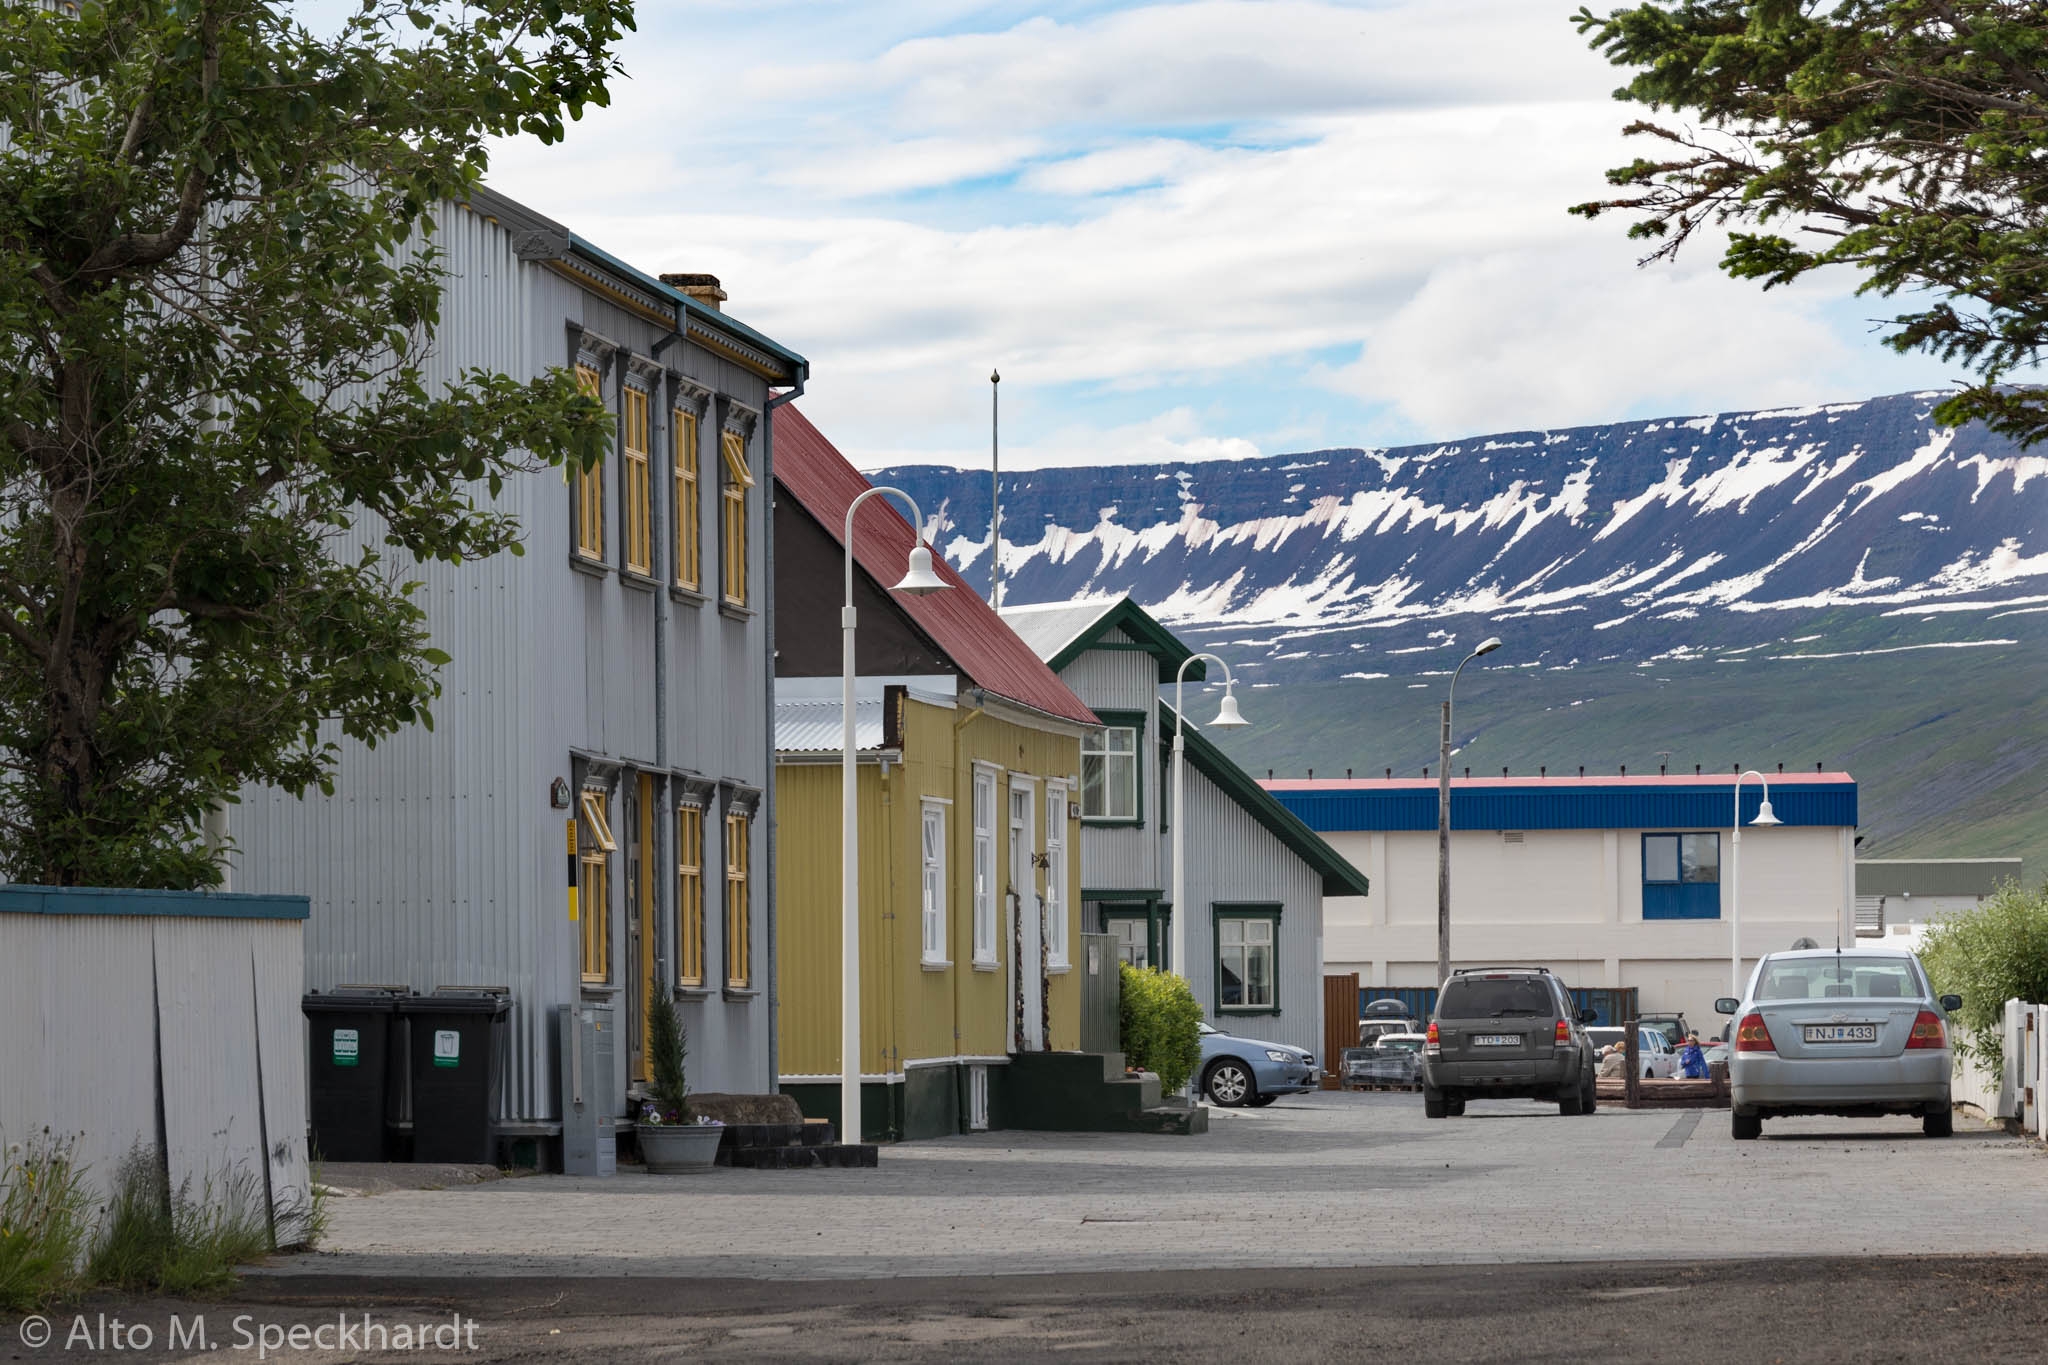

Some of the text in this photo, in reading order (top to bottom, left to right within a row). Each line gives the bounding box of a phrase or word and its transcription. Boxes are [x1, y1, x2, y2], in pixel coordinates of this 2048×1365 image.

[1816, 1028, 1873, 1039] NJ 433
[1502, 1036, 1519, 1044] 203
